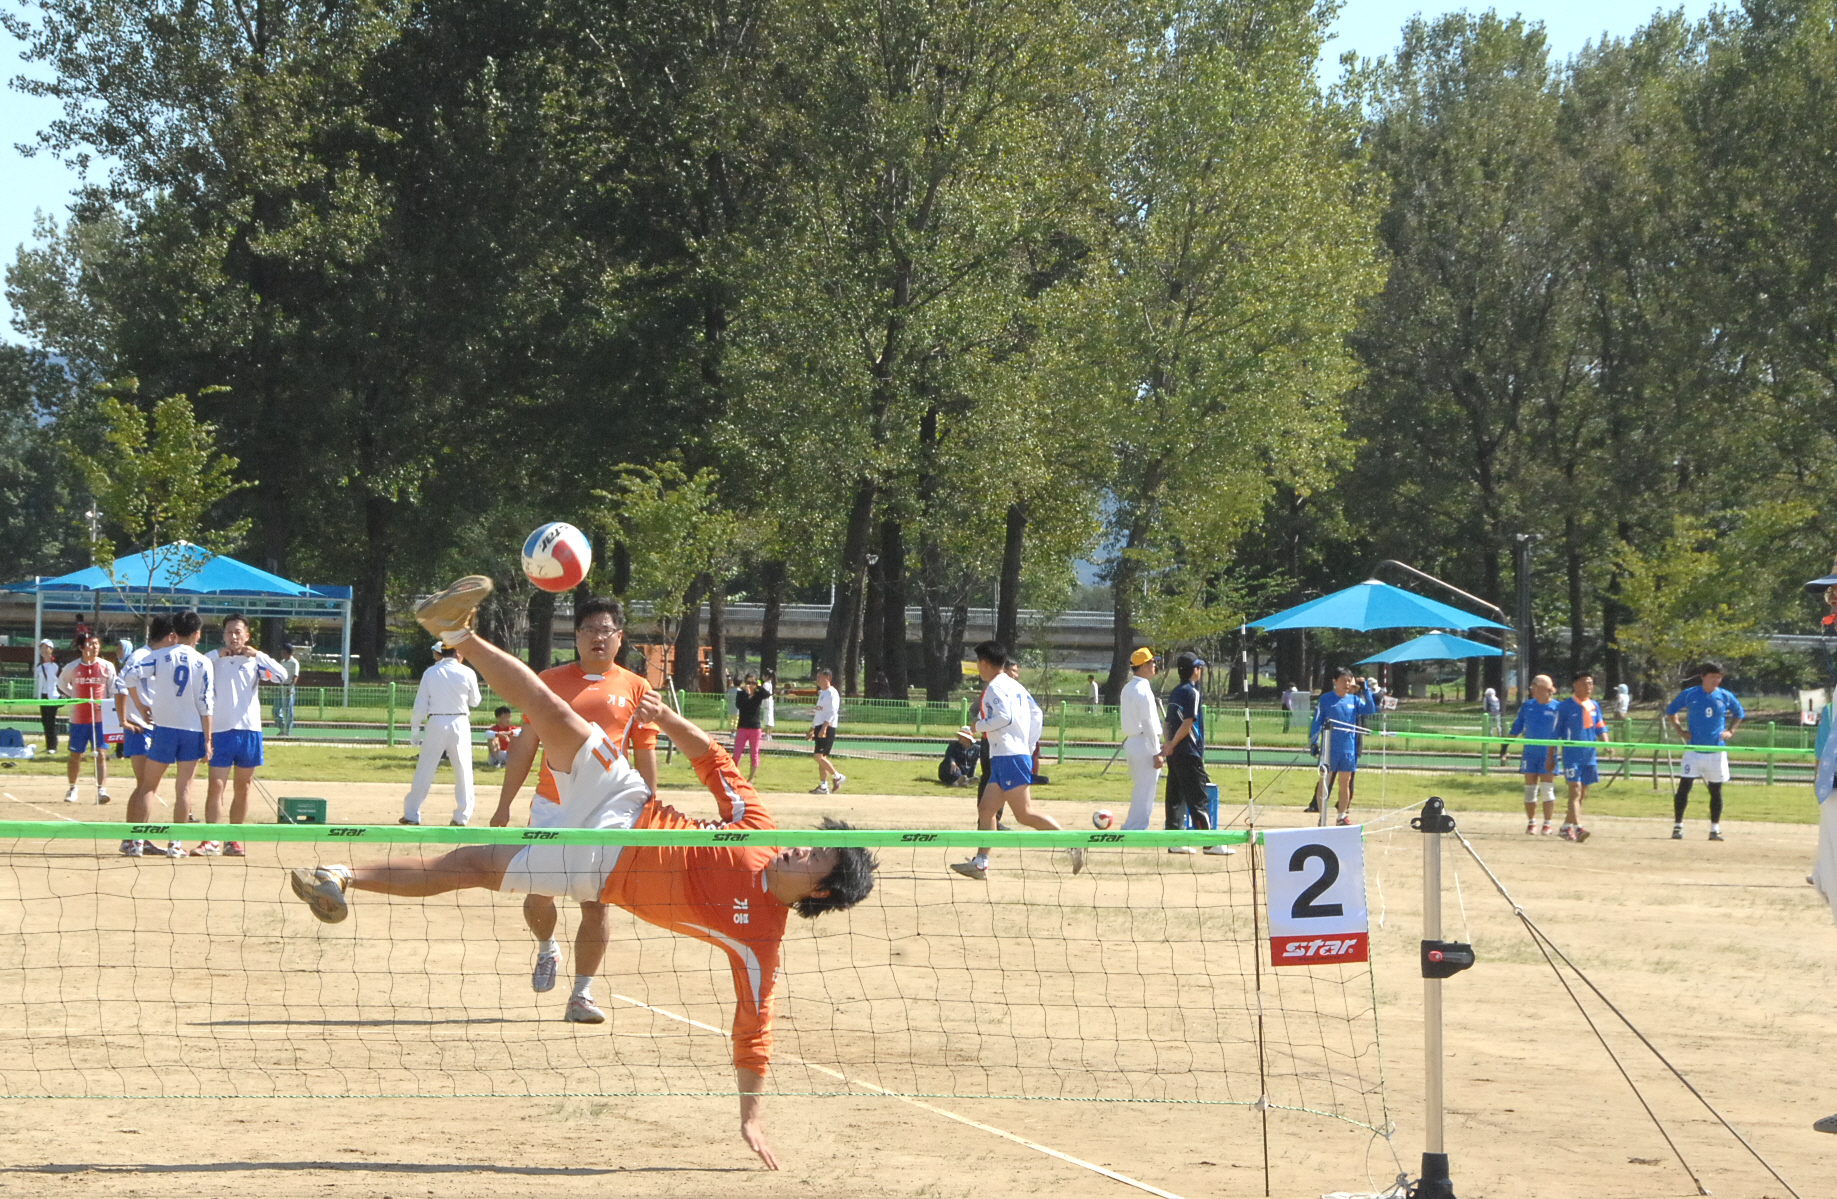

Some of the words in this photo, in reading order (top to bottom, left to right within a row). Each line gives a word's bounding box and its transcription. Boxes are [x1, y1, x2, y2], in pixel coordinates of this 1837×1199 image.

[173, 665, 190, 697] 9
[1705, 707, 1713, 718] 9
[1565, 767, 1575, 778] 13
[1288, 843, 1344, 919] 2
[1282, 939, 1358, 957] star
